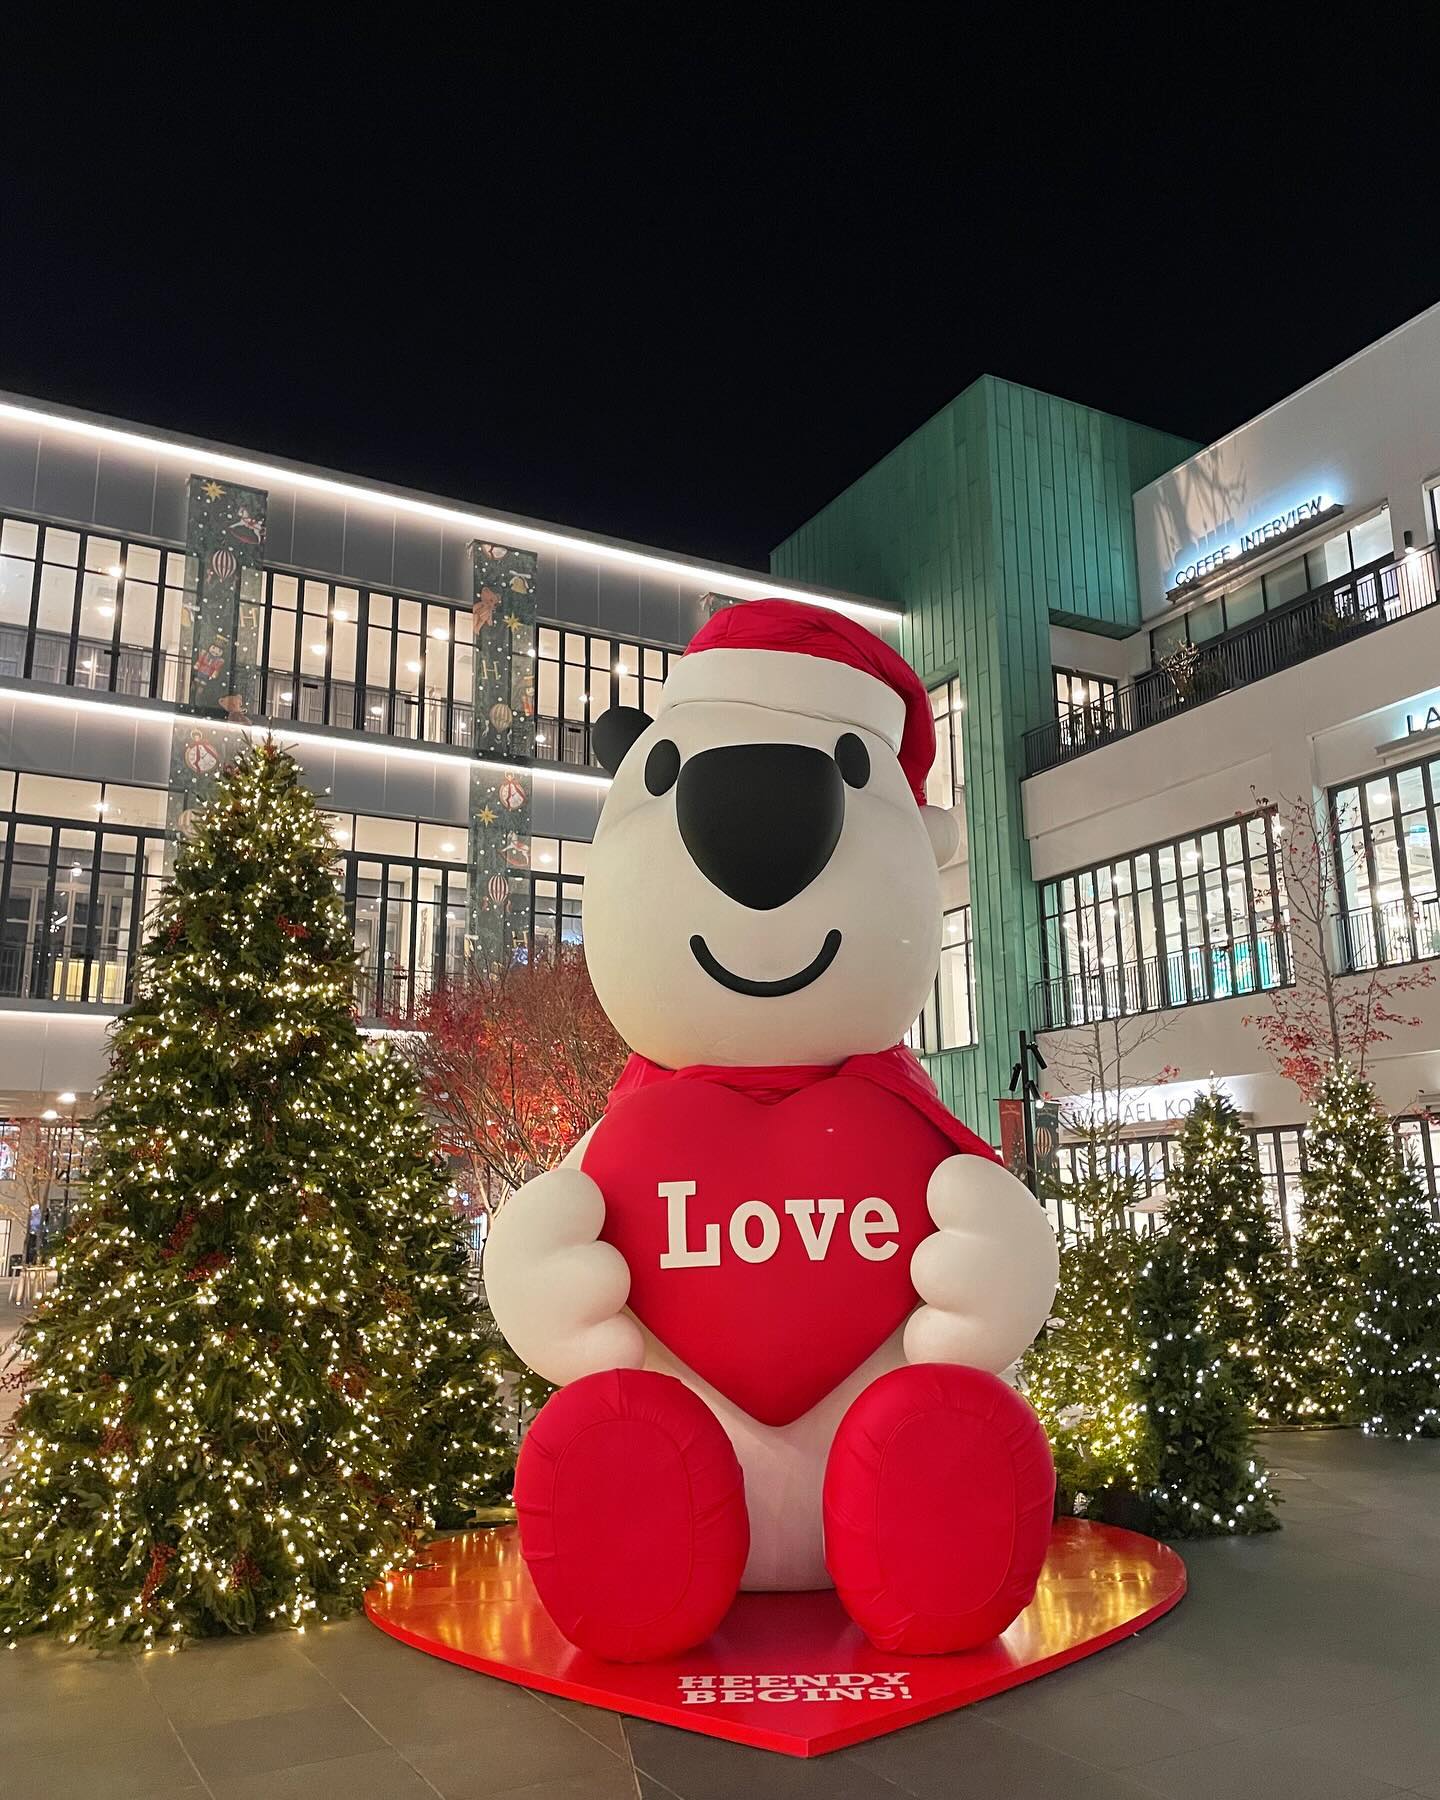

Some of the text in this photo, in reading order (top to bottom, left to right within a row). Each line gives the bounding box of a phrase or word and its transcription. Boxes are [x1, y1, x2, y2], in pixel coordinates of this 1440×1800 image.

[1175, 496, 1322, 585] COFFEE INTERVIEW
[657, 1180, 900, 1269] Love
[676, 1672, 911, 1689] HEENDY
[680, 1686, 913, 1705] BEGINS!
